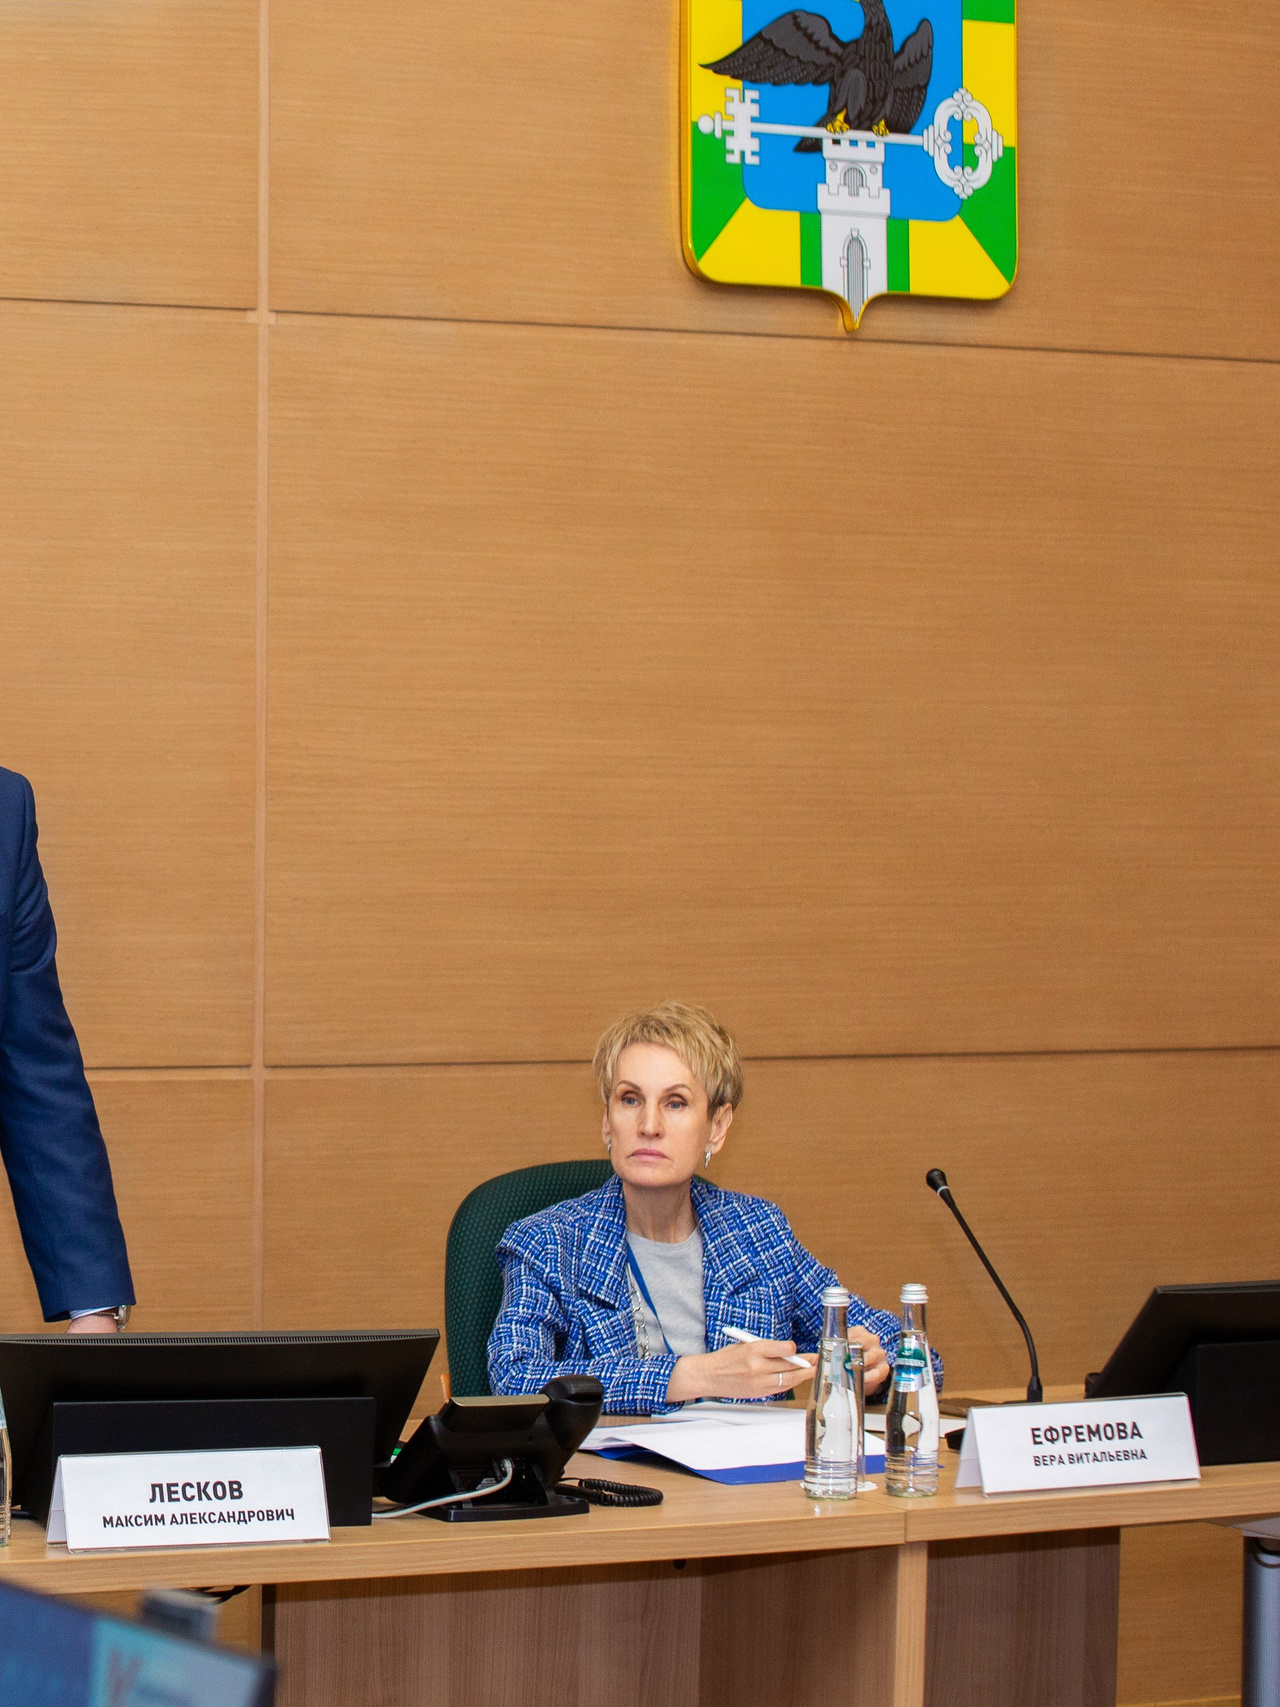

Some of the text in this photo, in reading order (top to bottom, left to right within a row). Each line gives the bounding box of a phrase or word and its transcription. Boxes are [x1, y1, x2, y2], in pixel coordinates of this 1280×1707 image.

[1031, 1421, 1144, 1445] ЕФРЕМОВА
[1033, 1449, 1147, 1466] ВЕРА ВИТАЛЬЕВНА
[149, 1480, 244, 1503] ЛЕСКОВ
[102, 1508, 295, 1528] МАКСИМ АЛЕКСАНДРОВИЧ
